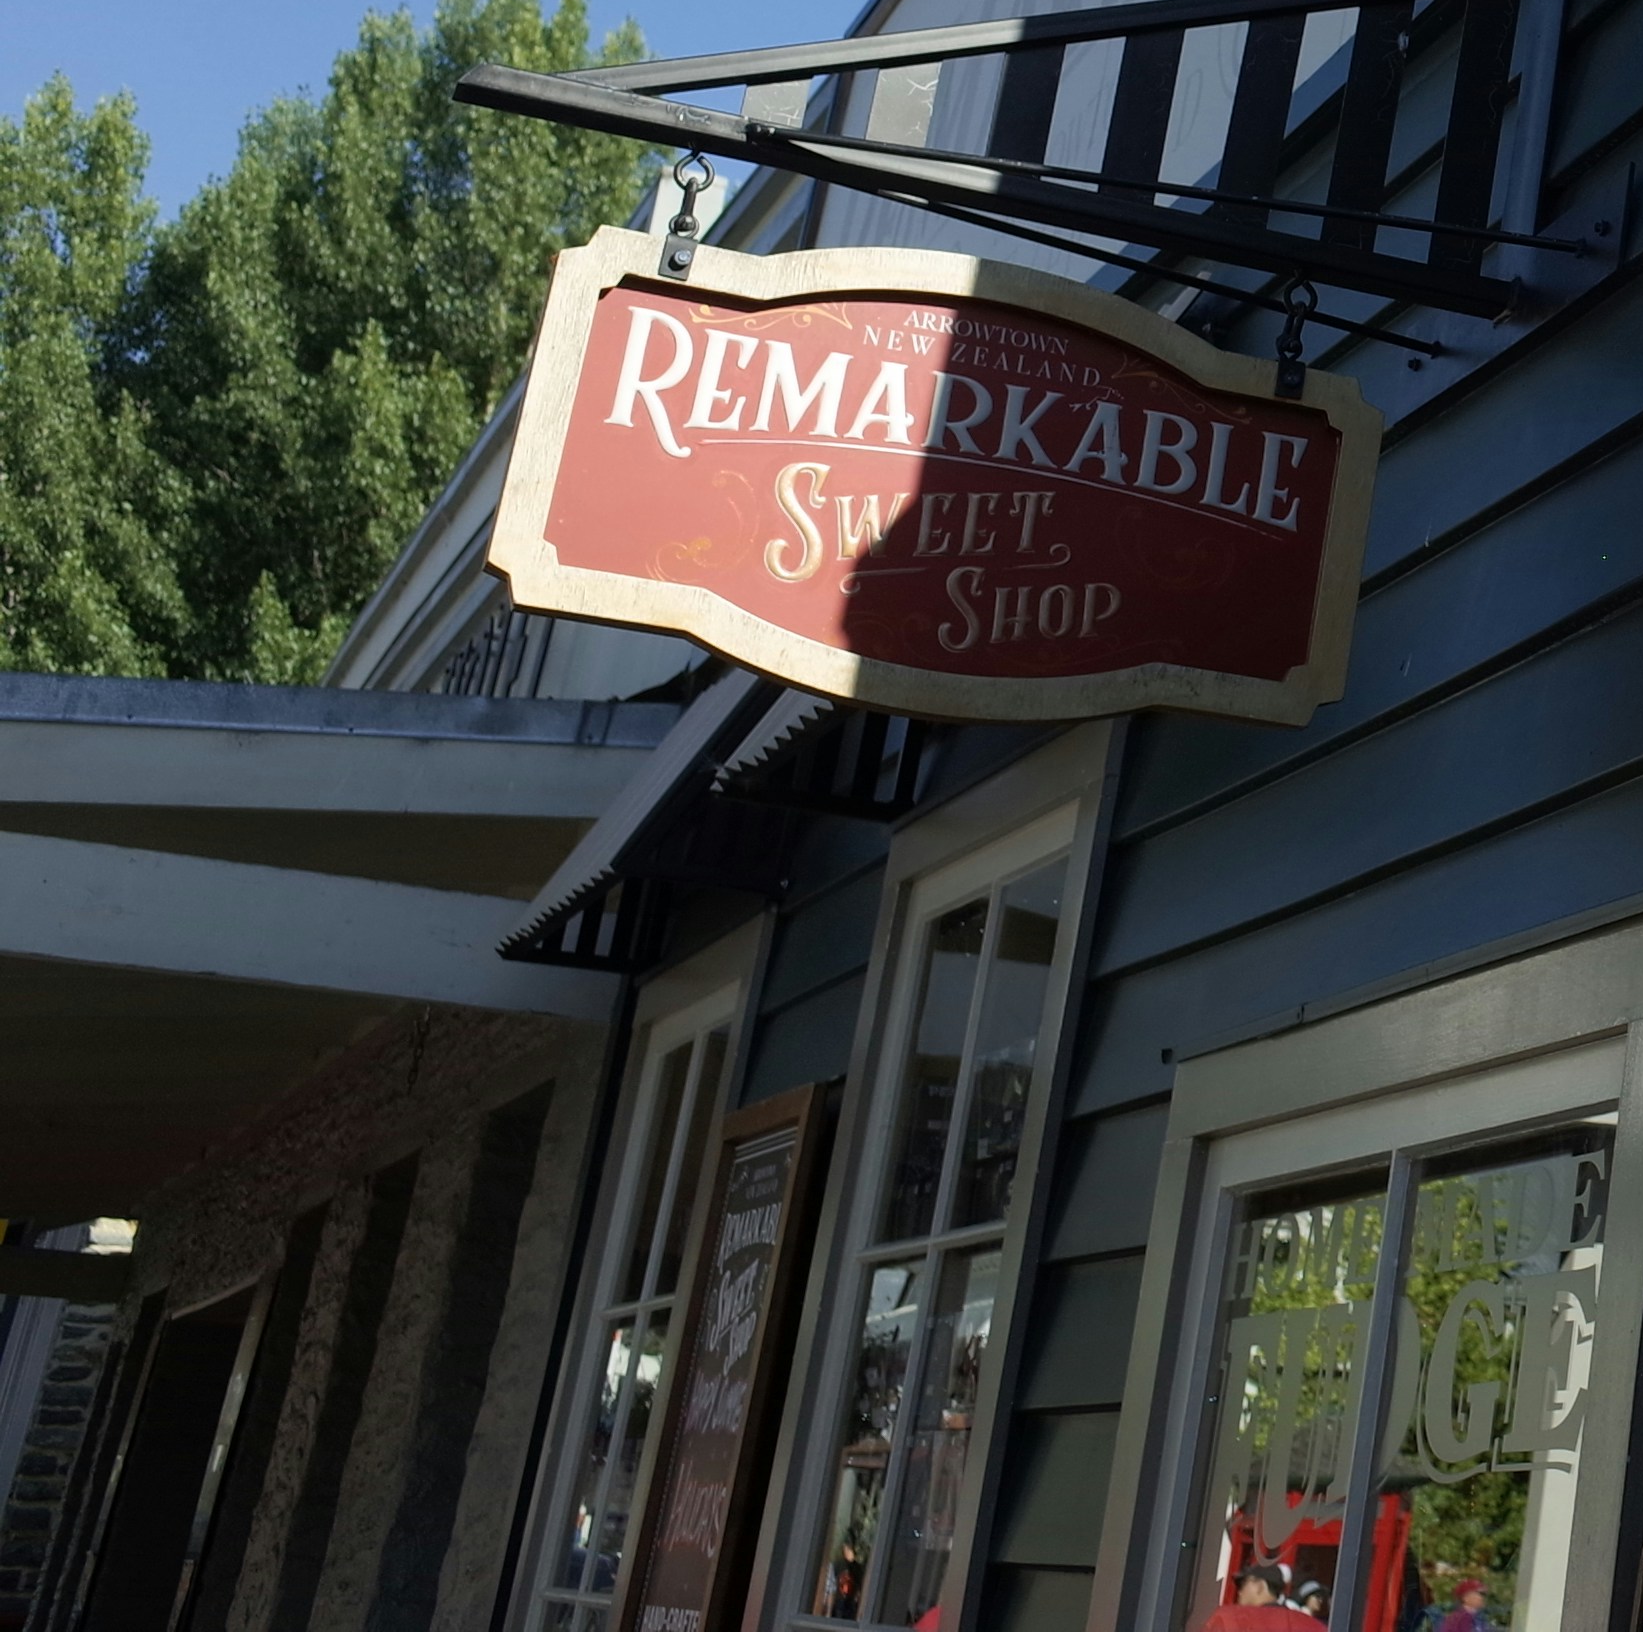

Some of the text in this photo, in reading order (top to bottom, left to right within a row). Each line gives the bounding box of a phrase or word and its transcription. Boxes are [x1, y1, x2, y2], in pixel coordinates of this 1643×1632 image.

[861, 324, 1101, 388] NEW ZEALAND
[903, 309, 1070, 356] ARROWTOWN
[603, 306, 1309, 532] REMARKABLE
[764, 461, 1056, 583] SWEET
[938, 567, 1123, 652] SHOP
